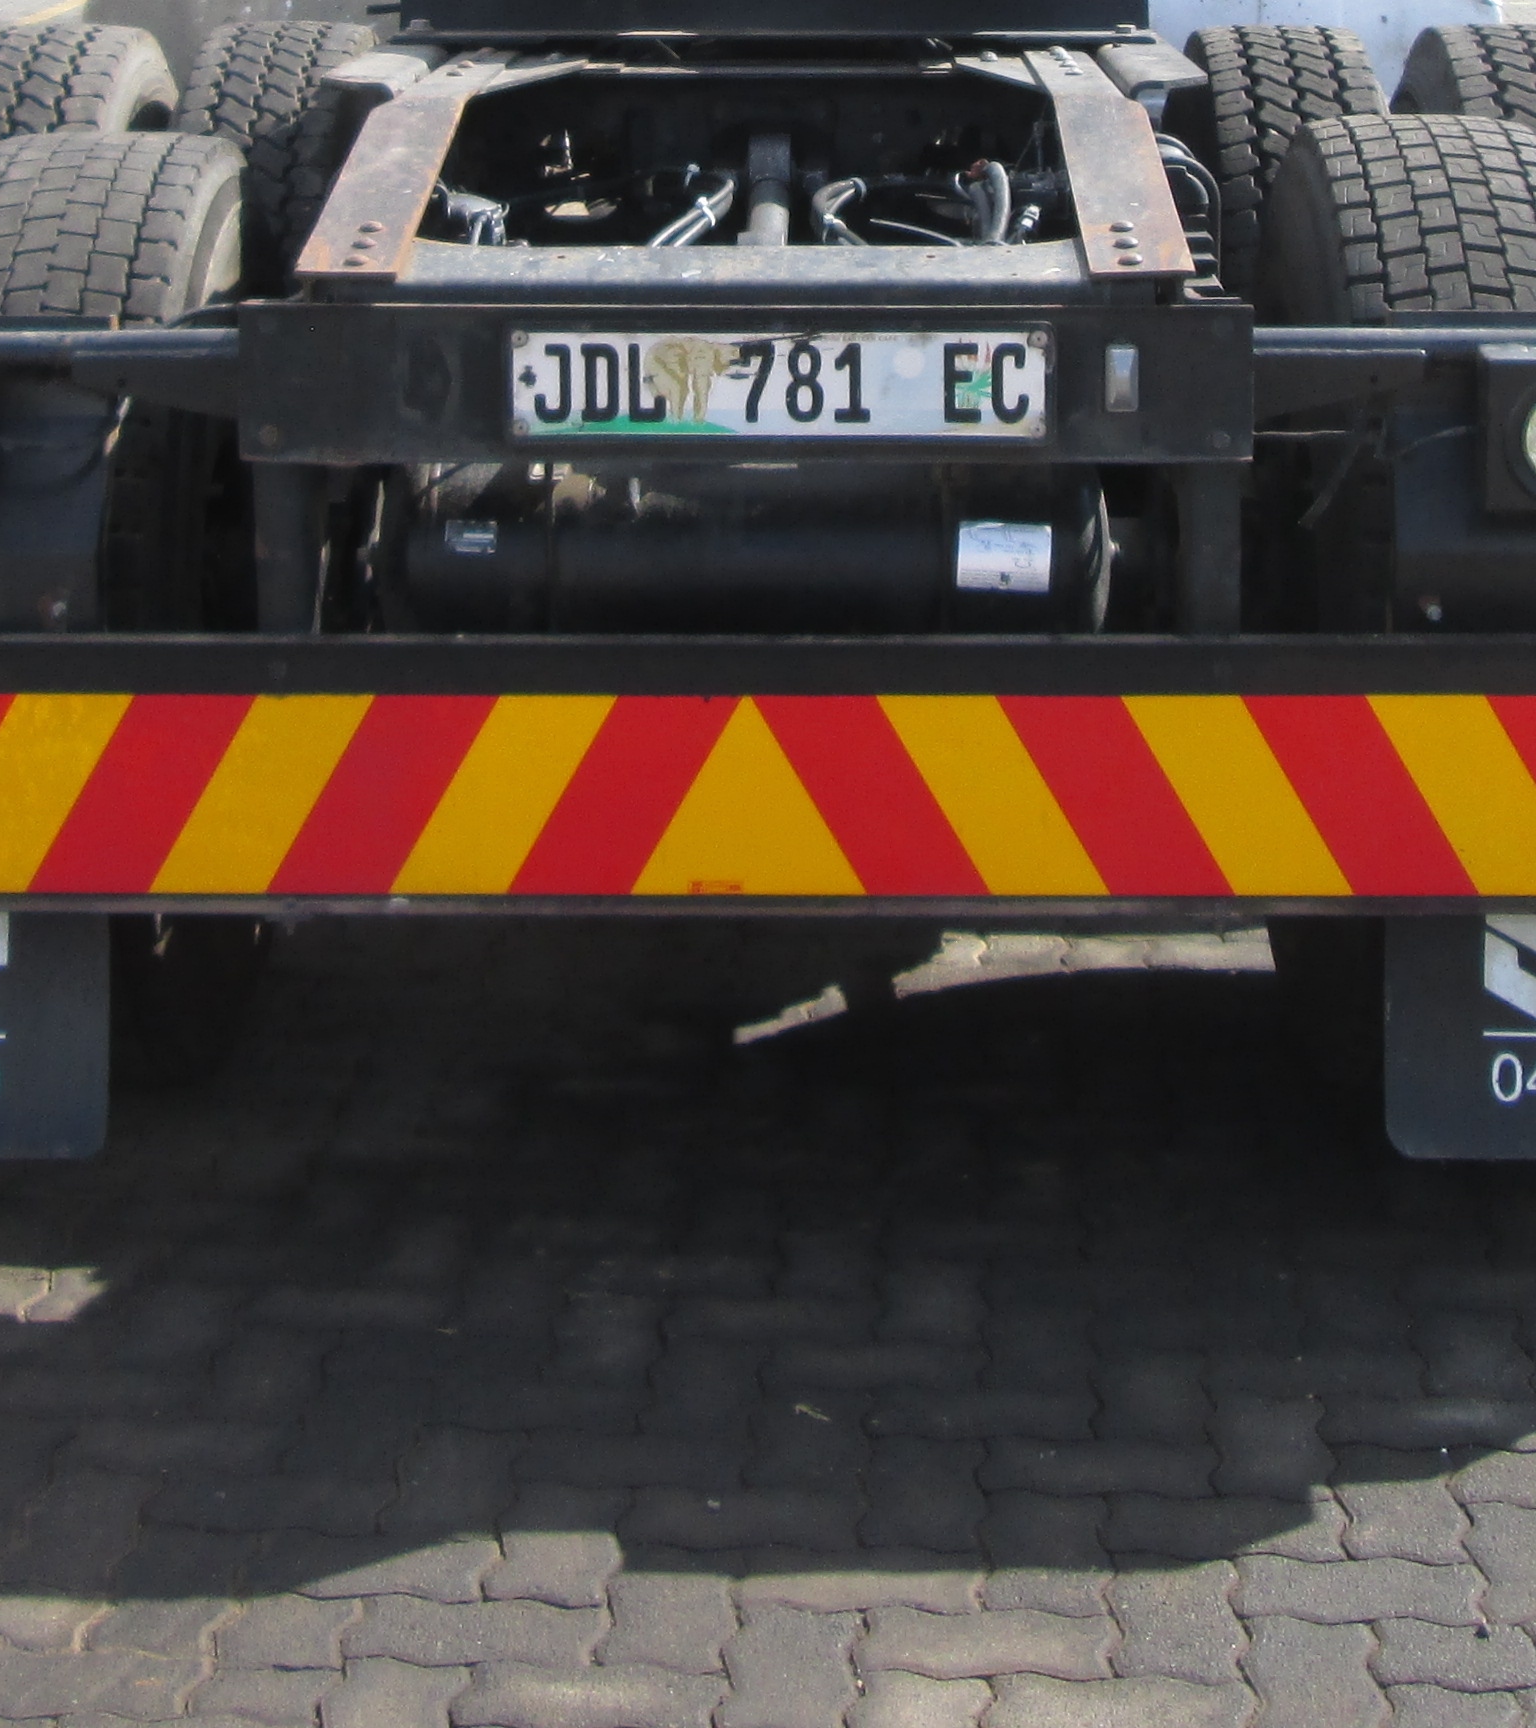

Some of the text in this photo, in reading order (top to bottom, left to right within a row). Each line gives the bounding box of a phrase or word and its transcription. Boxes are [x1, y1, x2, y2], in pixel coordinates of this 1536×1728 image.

[534, 341, 1030, 425] JDL 781 EC
